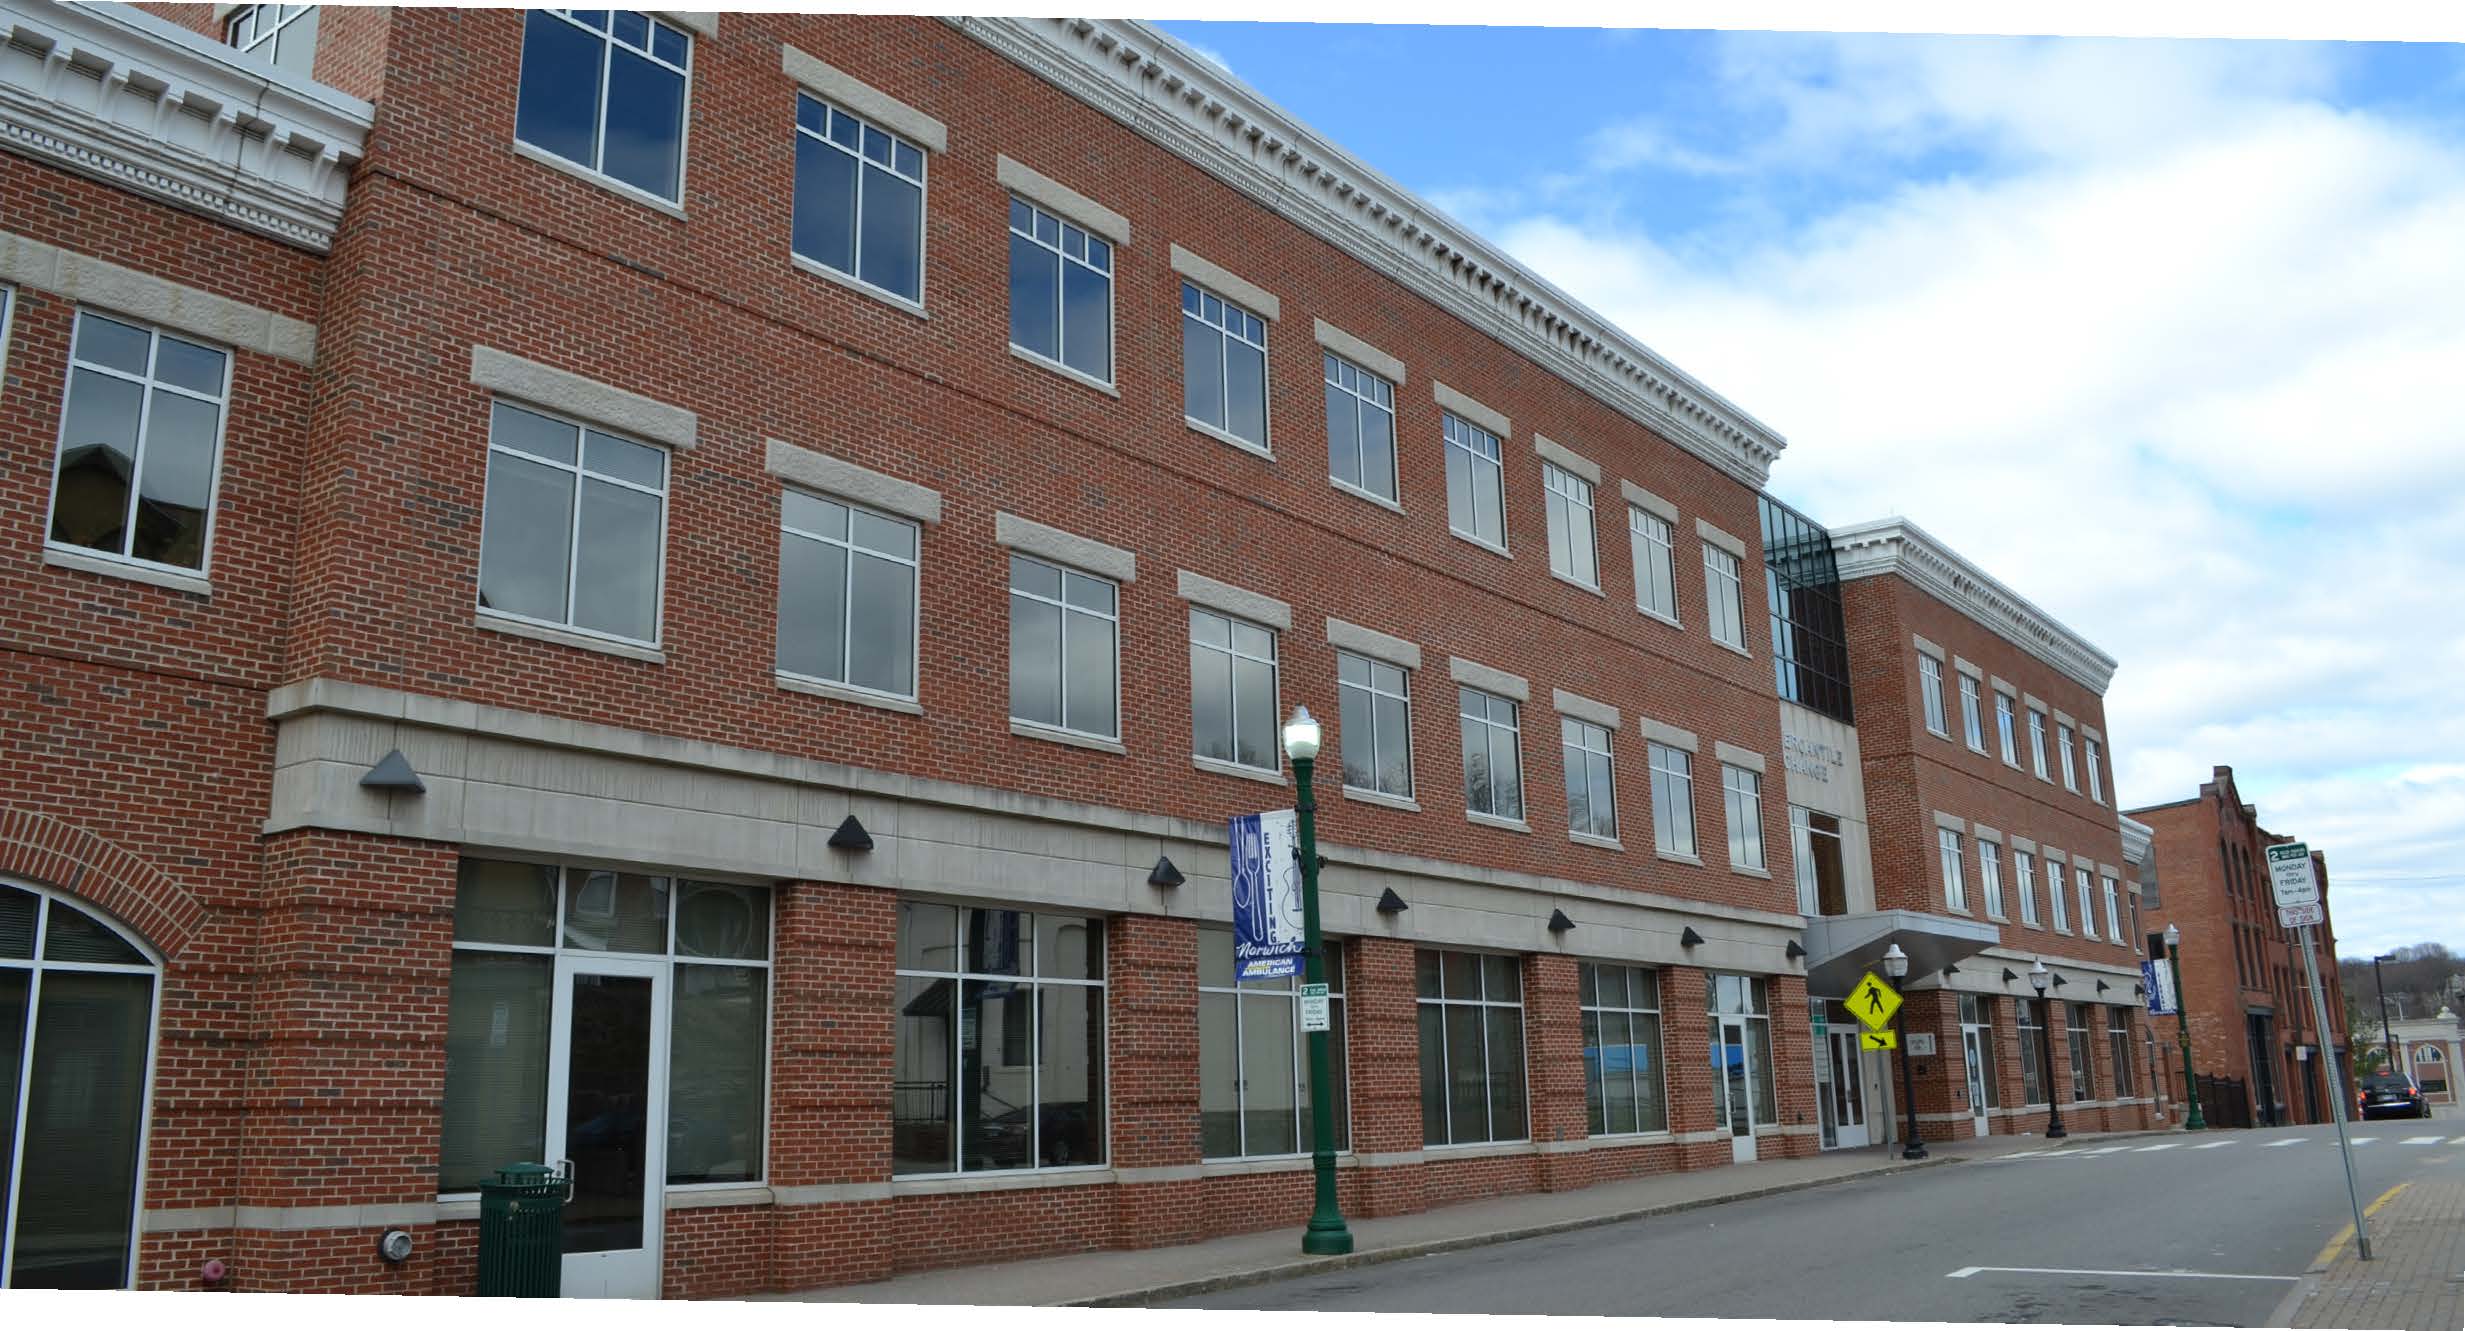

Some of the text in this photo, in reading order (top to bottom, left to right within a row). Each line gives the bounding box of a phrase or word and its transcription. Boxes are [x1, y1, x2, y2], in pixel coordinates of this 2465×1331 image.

[2270, 851, 2280, 861] 2
[2275, 863, 2305, 872] MONDAY
[2280, 878, 2305, 887] FRIDAY
[1263, 832, 1277, 944] EXCITING
[1236, 936, 1303, 959] Norwich
[1248, 958, 1293, 968] AMERICAN
[1242, 966, 1296, 977] AMBULANCE
